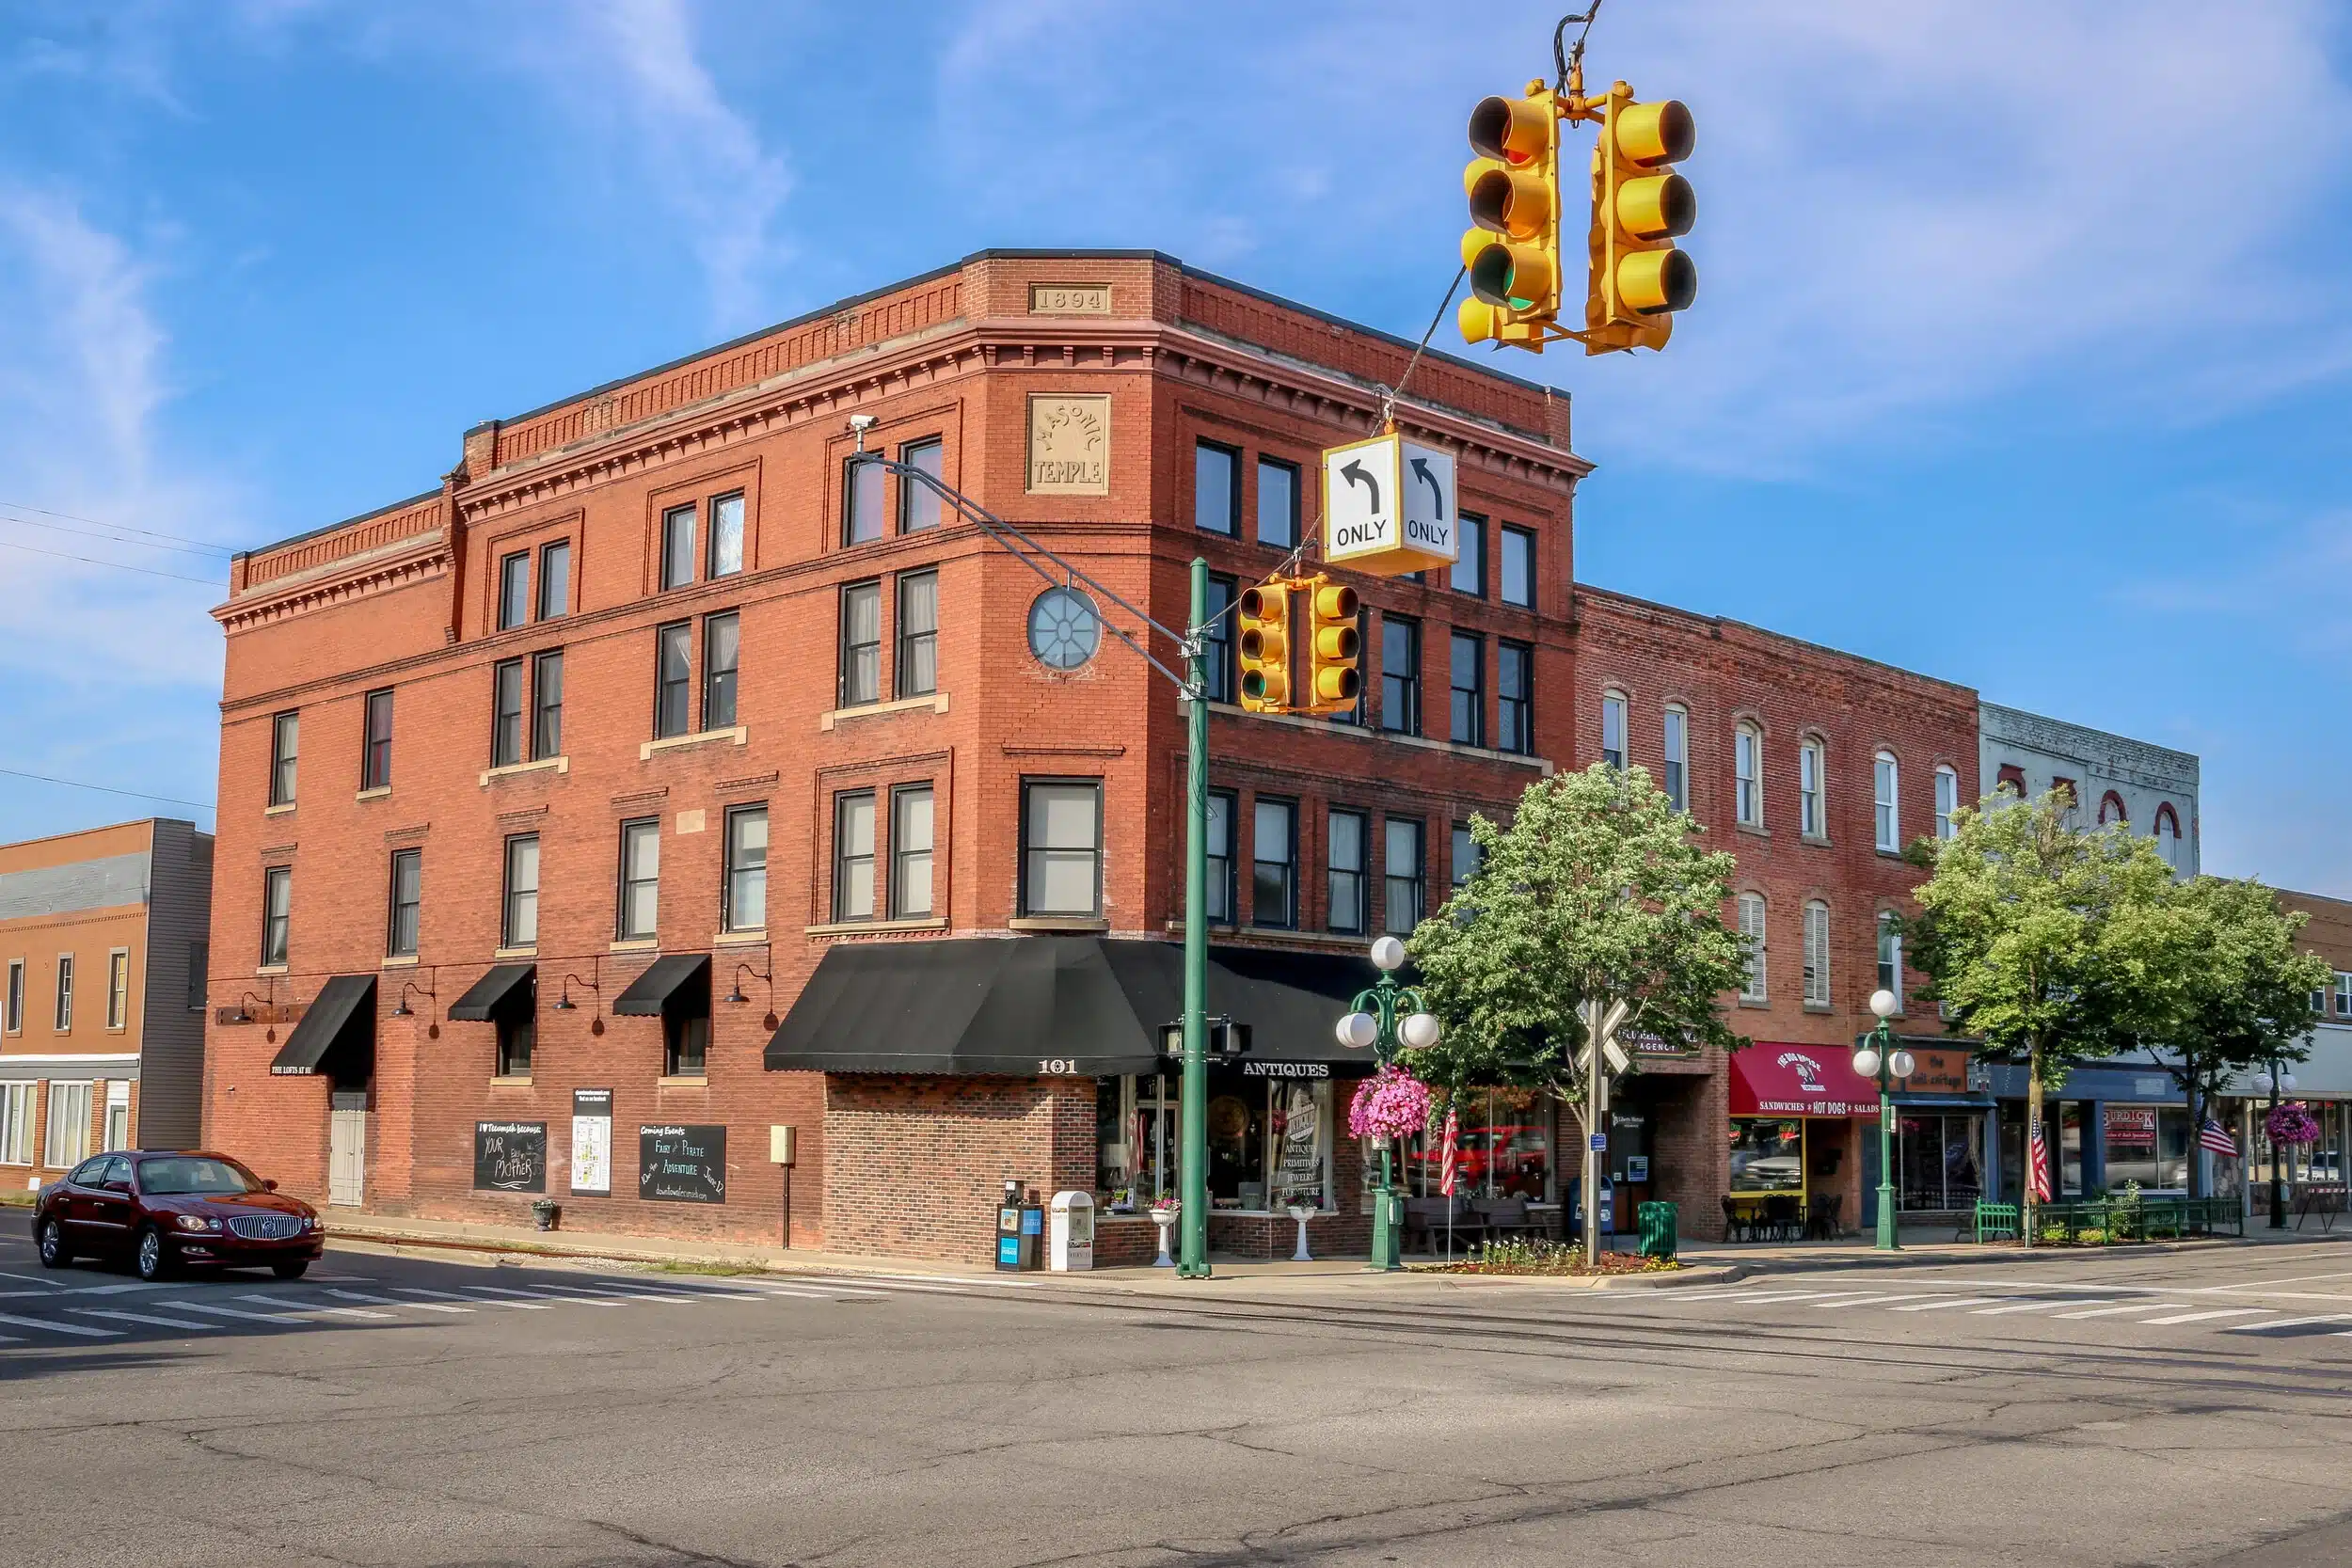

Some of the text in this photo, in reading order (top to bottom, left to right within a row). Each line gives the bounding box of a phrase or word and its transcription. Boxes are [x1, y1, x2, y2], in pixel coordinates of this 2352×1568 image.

[1039, 292, 1101, 309] 1894
[1036, 404, 1101, 451] MASONIC
[1034, 461, 1102, 483] TEMPLE
[1337, 518, 1387, 546] ONLY
[1408, 519, 1449, 546] ONLY
[271, 1066, 282, 1074] THE
[283, 1066, 297, 1074] LOFTS
[297, 1066, 305, 1074] AT
[1038, 1059, 1078, 1074] 101
[1243, 1062, 1329, 1077] ANTIQUES
[1759, 1101, 1880, 1115] SANDWICHES HOT DOGS SALADS
[640, 1126, 685, 1137] Coming Events
[1285, 1144, 1318, 1155] ANTIQUES
[662, 1158, 698, 1176] ADVENTURE
[1283, 1159, 1320, 1167] PRIMITIVES
[1286, 1173, 1315, 1183] JEWELRY
